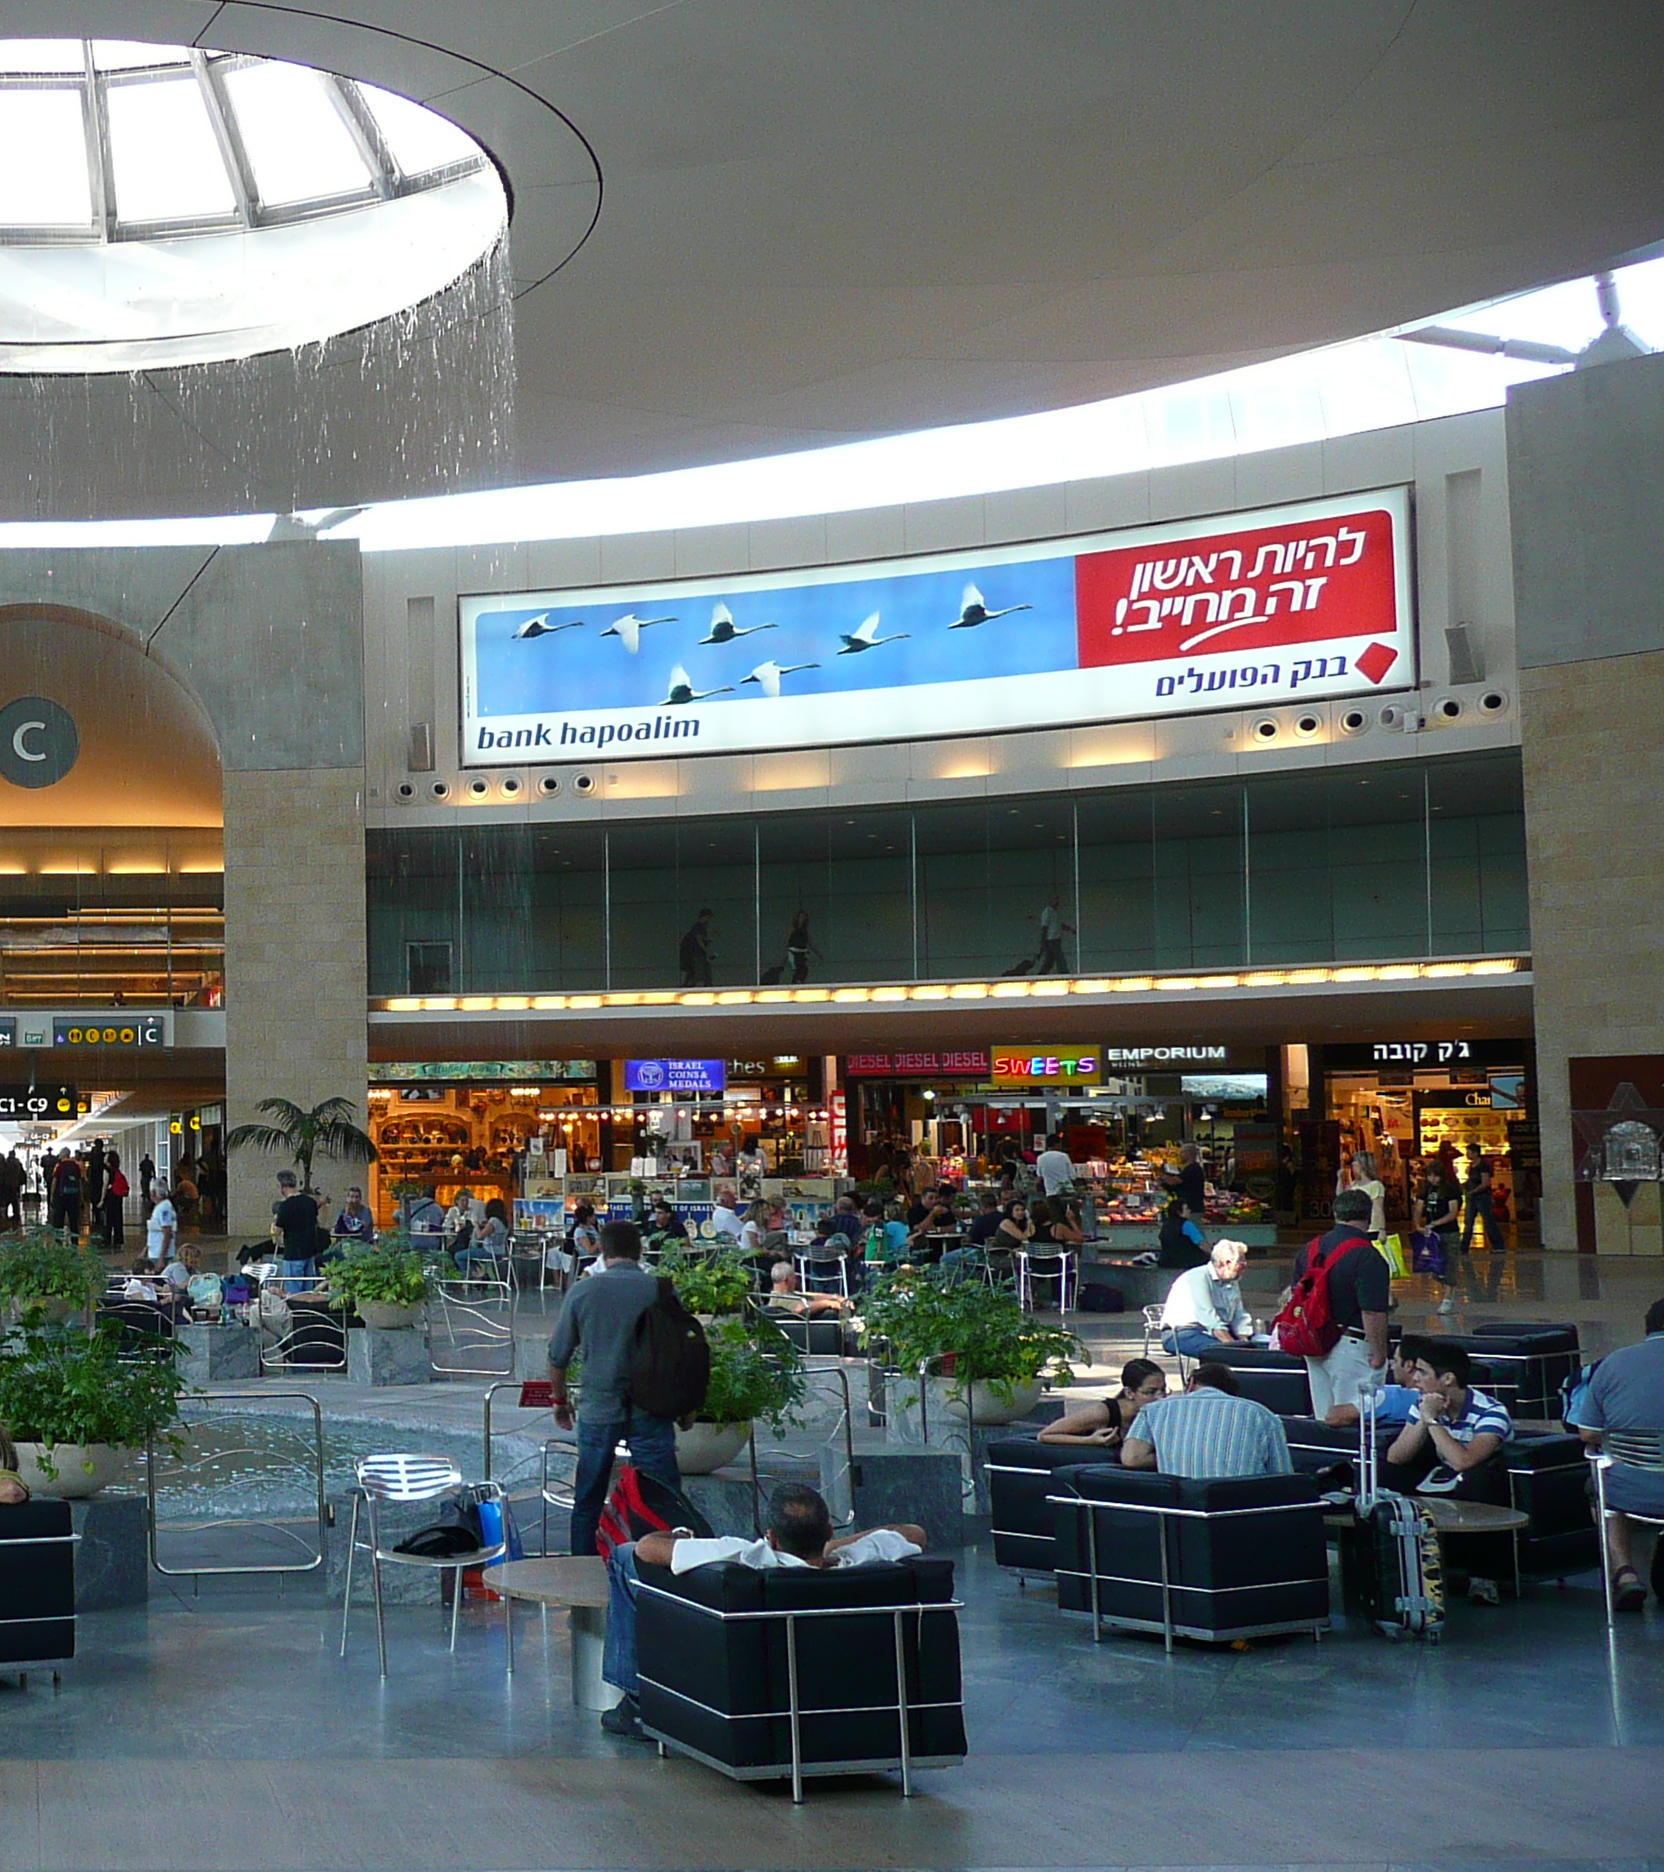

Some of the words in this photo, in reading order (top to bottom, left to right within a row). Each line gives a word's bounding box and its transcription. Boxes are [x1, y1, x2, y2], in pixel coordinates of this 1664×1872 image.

[1247, 526, 1367, 579] להיות
[1130, 550, 1242, 600] ראשון
[1264, 576, 1328, 616] זה
[1111, 587, 1257, 636] מחייב!
[1155, 663, 1281, 697] הפועלים
[1290, 655, 1348, 689] בנק
[12, 721, 47, 762] C
[477, 723, 553, 750] bank
[559, 715, 700, 749] hapoalim
[145, 1029, 157, 1043] C
[848, 1054, 891, 1069] DIESEL
[894, 1053, 938, 1068] DIESEL
[942, 1052, 988, 1067] DIESEL
[1108, 1046, 1226, 1061] EMPORIUM
[1373, 1043, 1428, 1063] קובה
[668, 1061, 704, 1070] ISRAEL
[993, 1057, 1096, 1076] SWEETS
[668, 1079, 712, 1089] MEDALS
